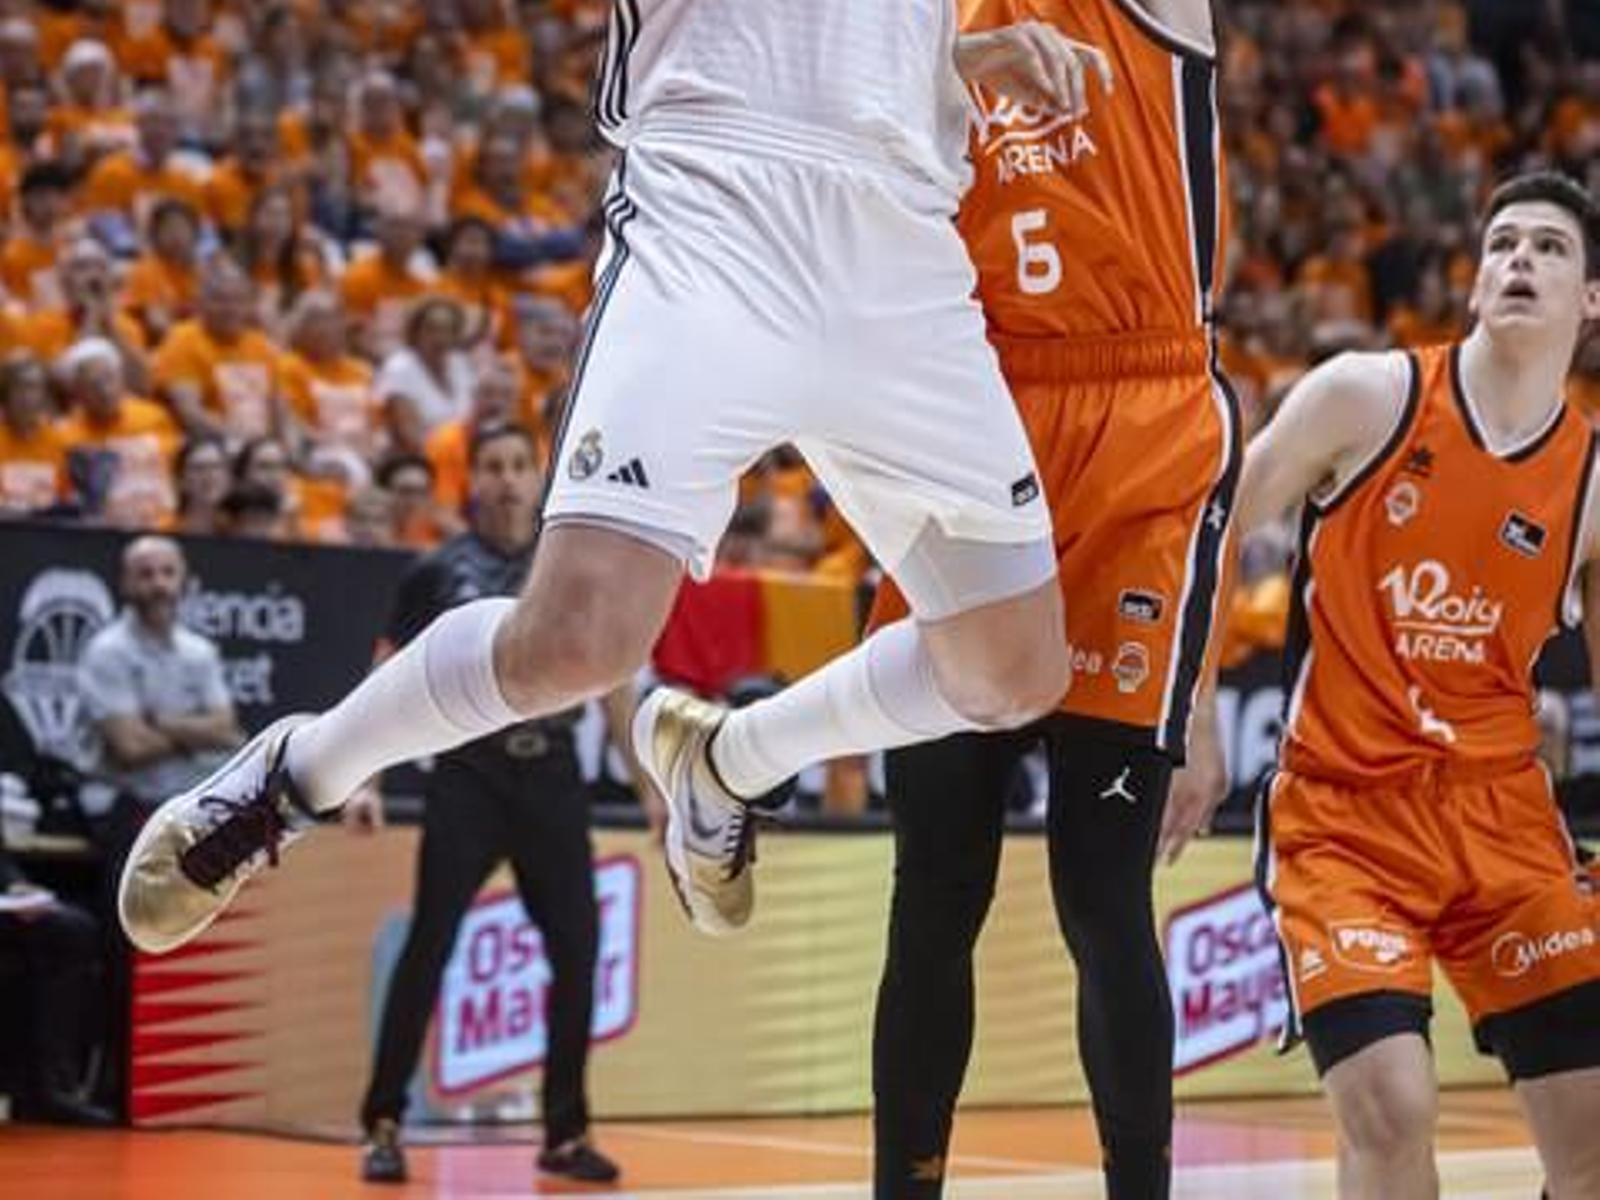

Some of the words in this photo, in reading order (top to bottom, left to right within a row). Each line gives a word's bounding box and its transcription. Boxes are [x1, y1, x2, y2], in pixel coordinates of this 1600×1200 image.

[1011, 208, 1063, 294] 6
[180, 577, 304, 641] lencia
[1394, 630, 1486, 663] ARENA
